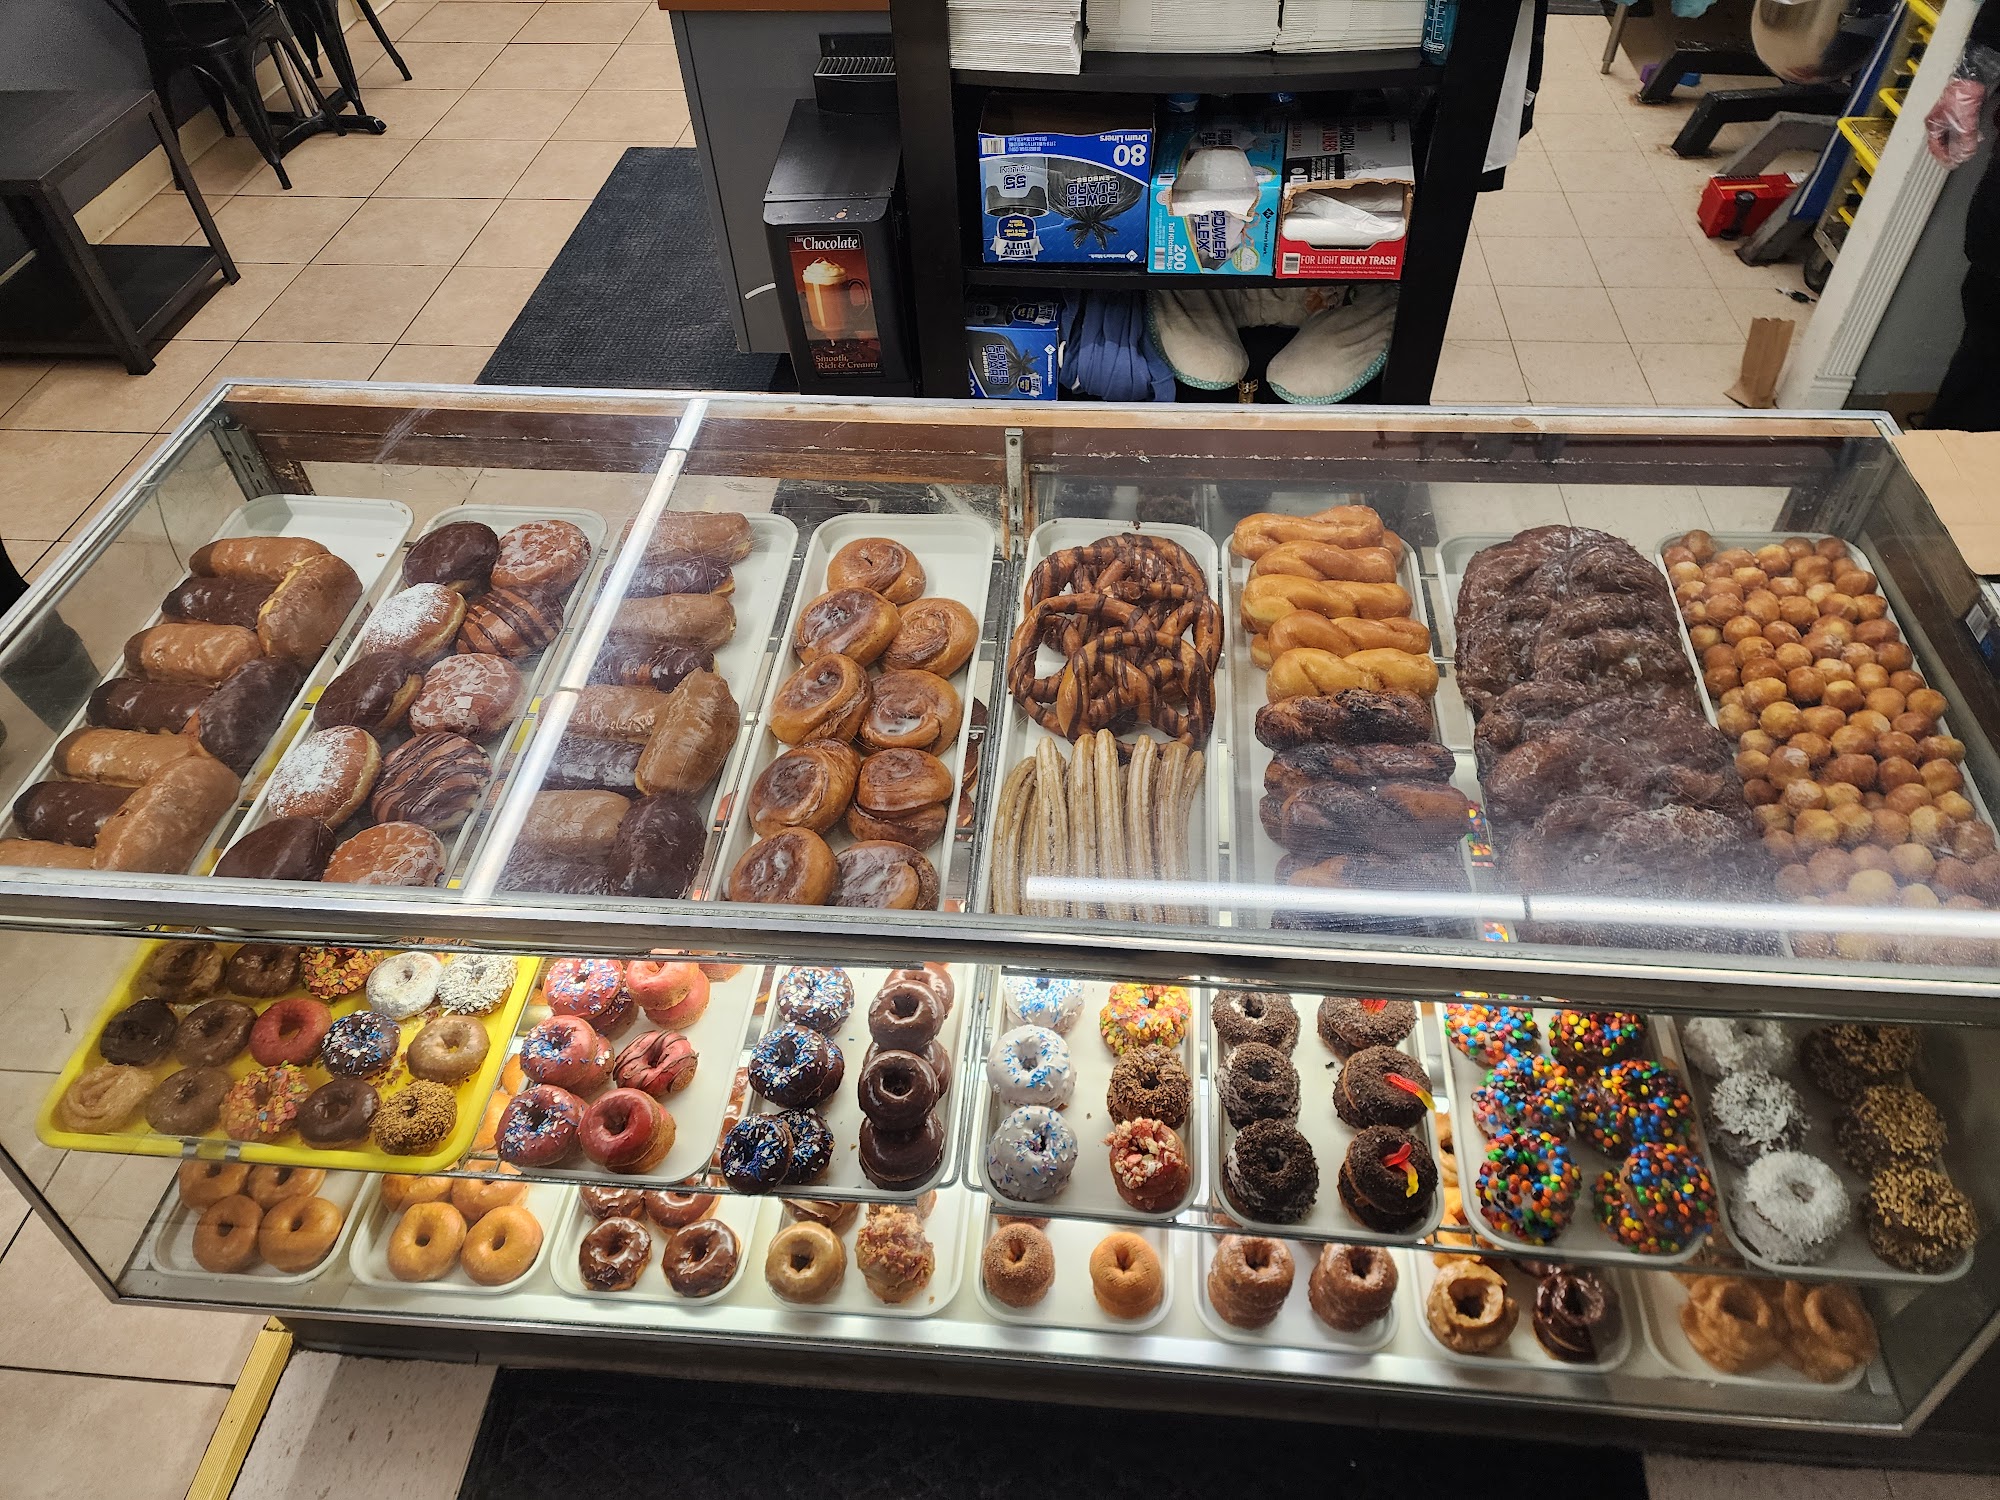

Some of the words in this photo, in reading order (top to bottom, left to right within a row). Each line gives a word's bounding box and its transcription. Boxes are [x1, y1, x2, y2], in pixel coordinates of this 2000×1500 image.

[1100, 134, 1124, 142] Liners
[1125, 134, 1147, 142] Drum
[1113, 144, 1147, 167] 80
[1003, 175, 1027, 190] 55
[1066, 181, 1120, 195] GUARD
[1066, 192, 1120, 207] POWER
[1194, 214, 1211, 253] FLEX
[1211, 210, 1227, 260] POWER
[803, 235, 858, 249] Chocolate
[1004, 242, 1031, 250] DUTY
[1167, 233, 1175, 255] Kitchen
[1173, 244, 1187, 271] 200
[1300, 255, 1316, 265] FOR
[1317, 255, 1339, 265] LIGHT
[1340, 255, 1367, 265] BULKY
[1369, 255, 1397, 266] TRASH
[815, 353, 849, 363] Smooth,
[986, 345, 998, 385] GUARD
[995, 345, 1010, 384] POWER
[818, 362, 837, 370] Rich
[847, 362, 879, 370] Creamy
